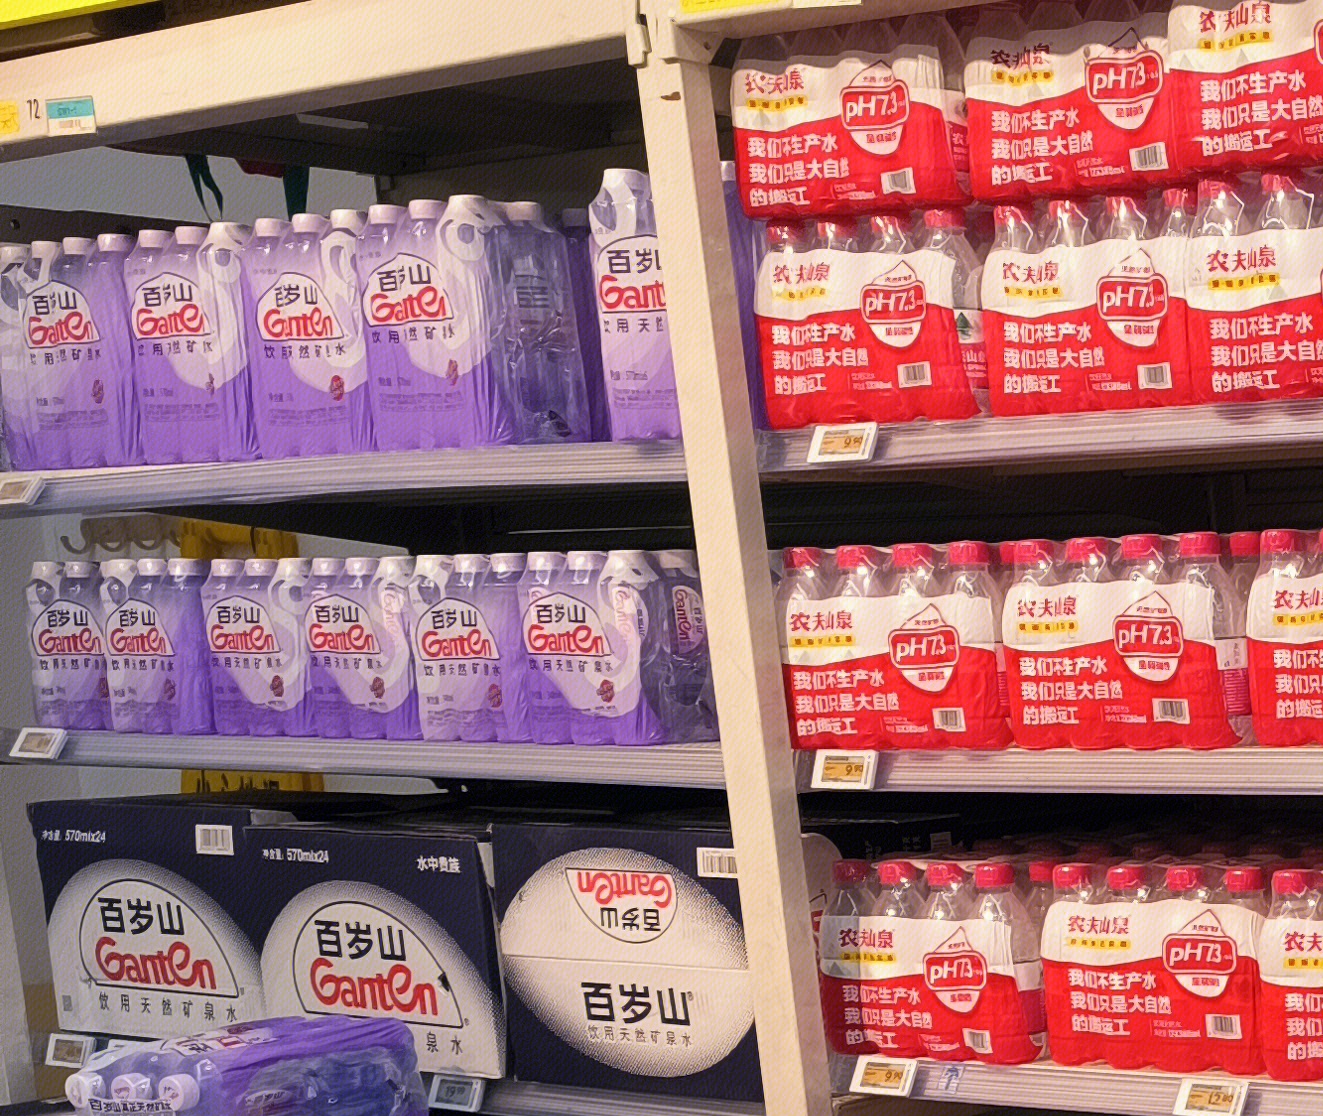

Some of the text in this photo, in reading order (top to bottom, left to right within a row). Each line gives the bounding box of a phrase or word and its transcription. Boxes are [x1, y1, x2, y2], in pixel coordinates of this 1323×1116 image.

[1201, 71, 1307, 101] 我们不生产水
[1202, 97, 1323, 128] 我们只是大自然
[576, 870, 672, 909] Ganten
[98, 898, 186, 935] 百岁山
[315, 920, 404, 959] 百岁山
[96, 938, 216, 991] Ganten
[99, 994, 238, 1022] 饮用天然矿泉水
[311, 959, 438, 1018] Ganten
[581, 982, 691, 1025] 百岁山
